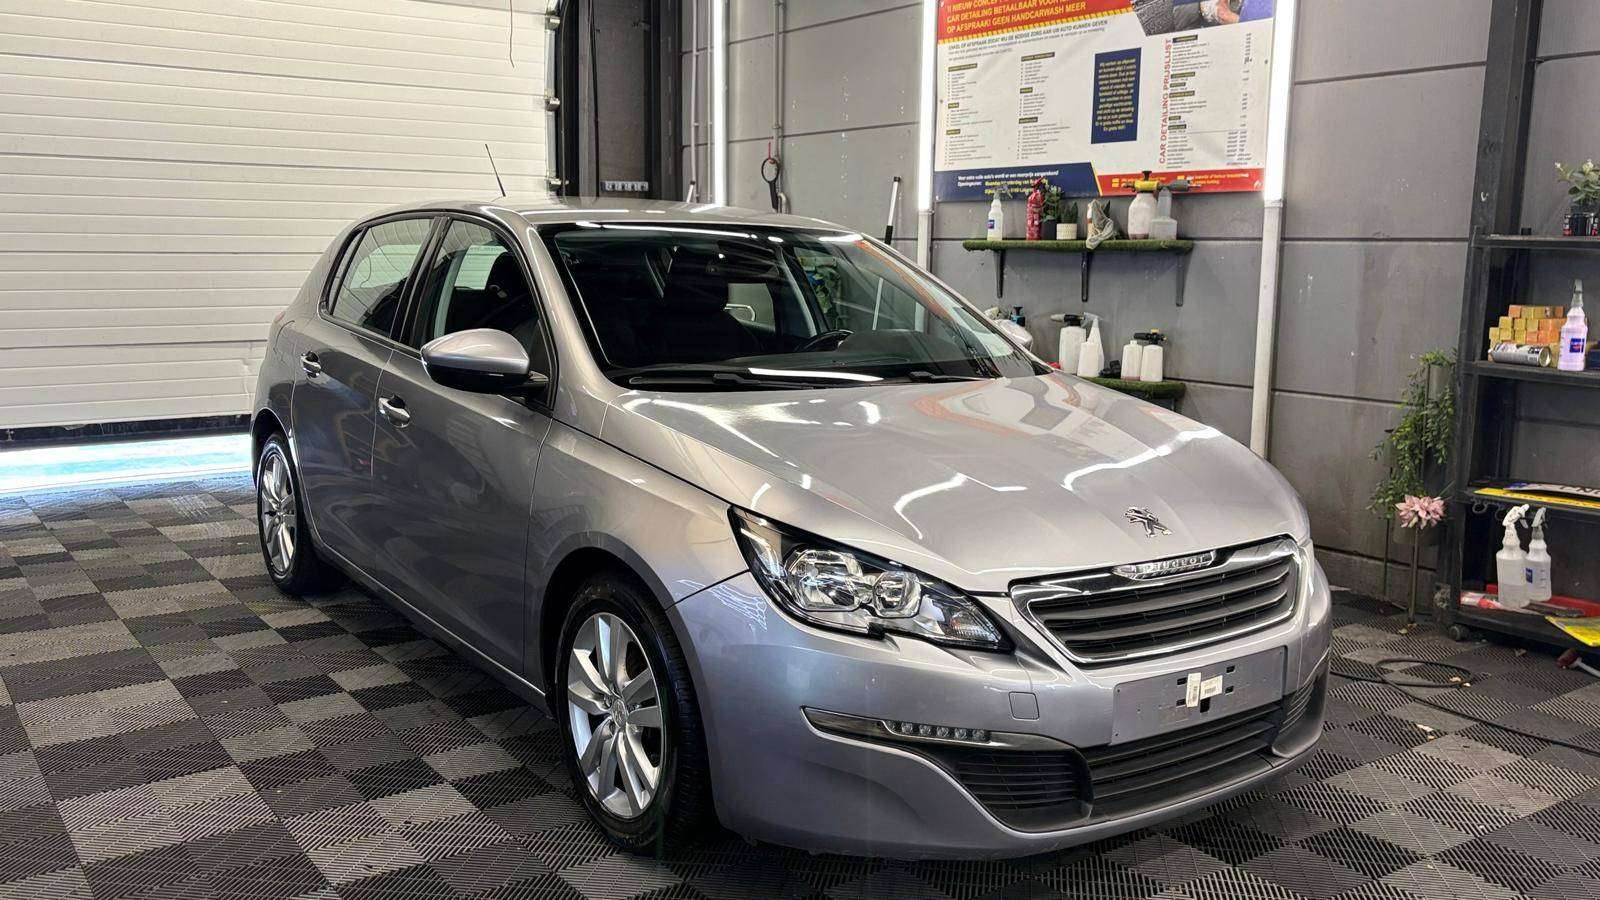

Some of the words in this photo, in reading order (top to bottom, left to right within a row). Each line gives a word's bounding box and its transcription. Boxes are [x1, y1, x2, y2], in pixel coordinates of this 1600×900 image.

[947, 15, 961, 23] CAR
[961, 8, 993, 21] DETAILING
[993, 1, 1038, 15] BETAALBAAR
[952, 1, 973, 12] NIEUW
[947, 25, 956, 33] OP
[956, 19, 991, 32] AFSPRAAK!
[992, 14, 1011, 26] GEEN
[1012, 7, 1064, 24] HANDCARWASH
[1065, 2, 1086, 13] MEER
[1160, 93, 1168, 141] DETAILING
[1159, 143, 1167, 164] CAR
[1143, 556, 1206, 572] PEUGEOT
